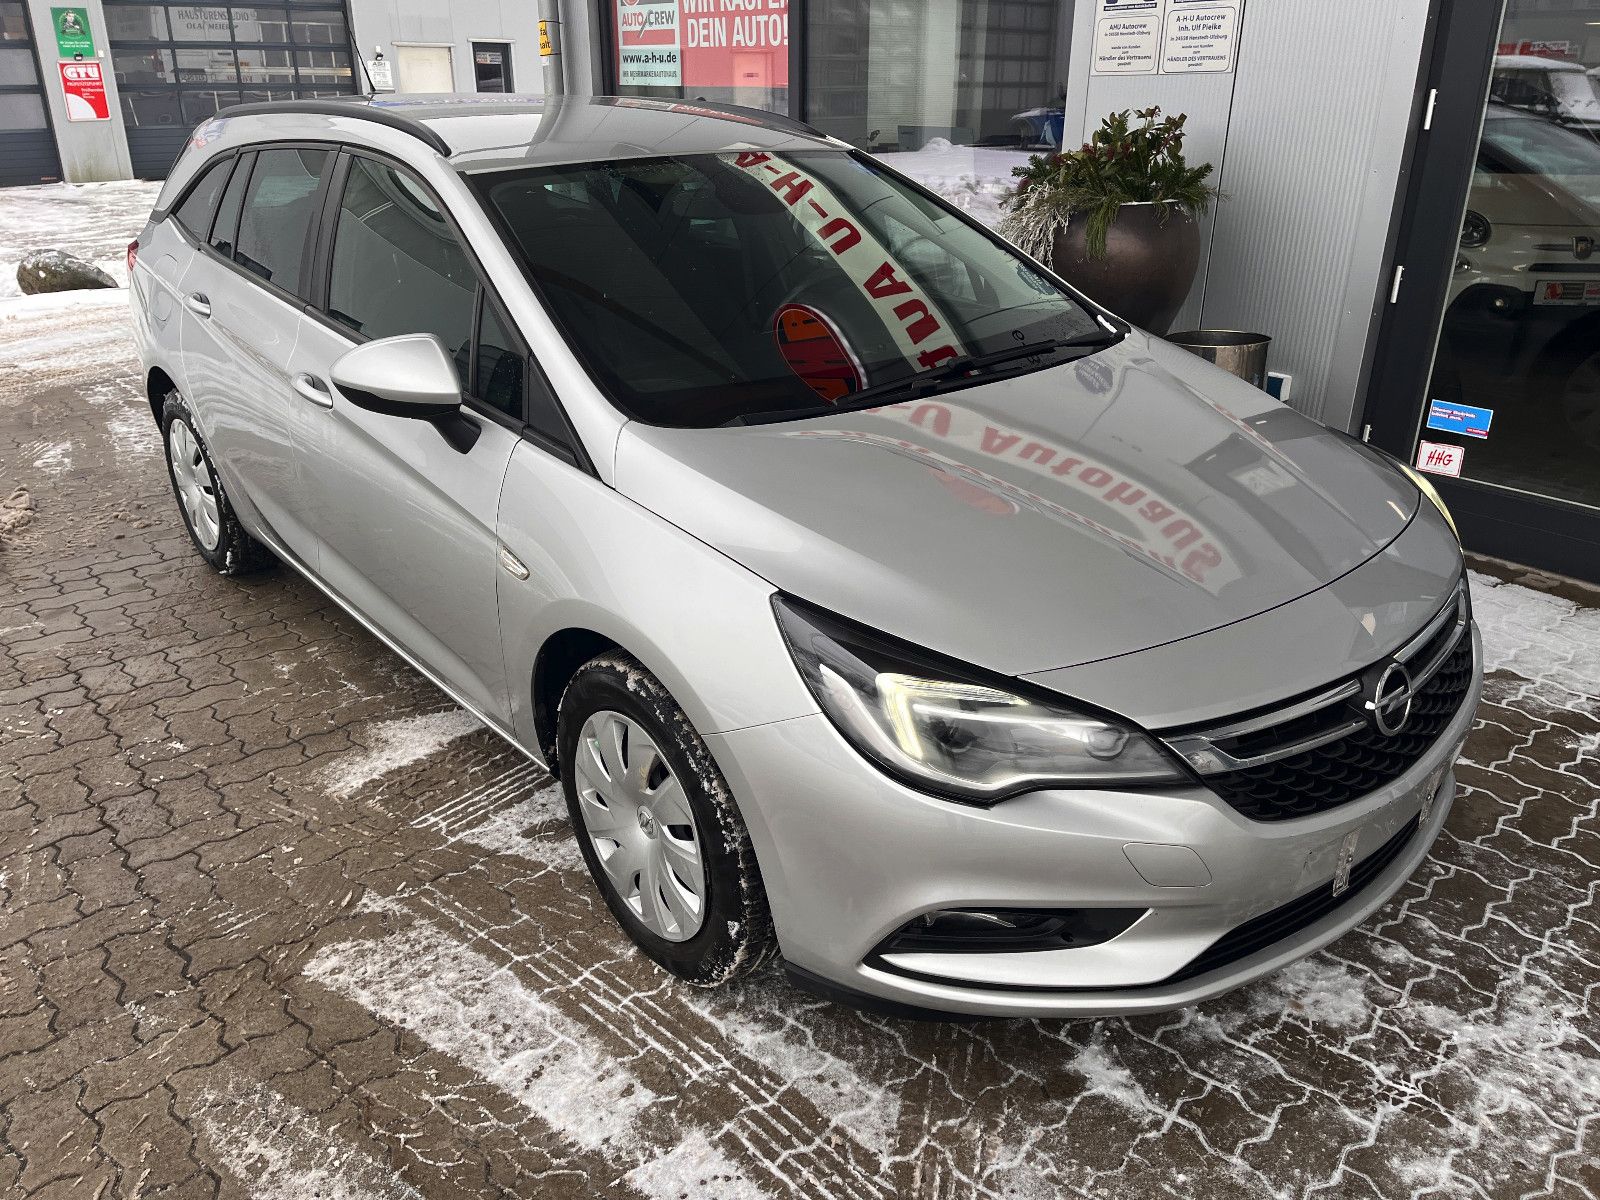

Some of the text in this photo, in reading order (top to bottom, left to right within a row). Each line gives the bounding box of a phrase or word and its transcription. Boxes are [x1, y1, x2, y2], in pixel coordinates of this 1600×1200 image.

[1175, 15, 1195, 23] A-H-U
[687, 14, 788, 48] DEIN AUTO!
[1191, 23, 1202, 31] Ulf
[622, 52, 677, 63] www.a-h-u.de
[1425, 449, 1454, 466] HHG
